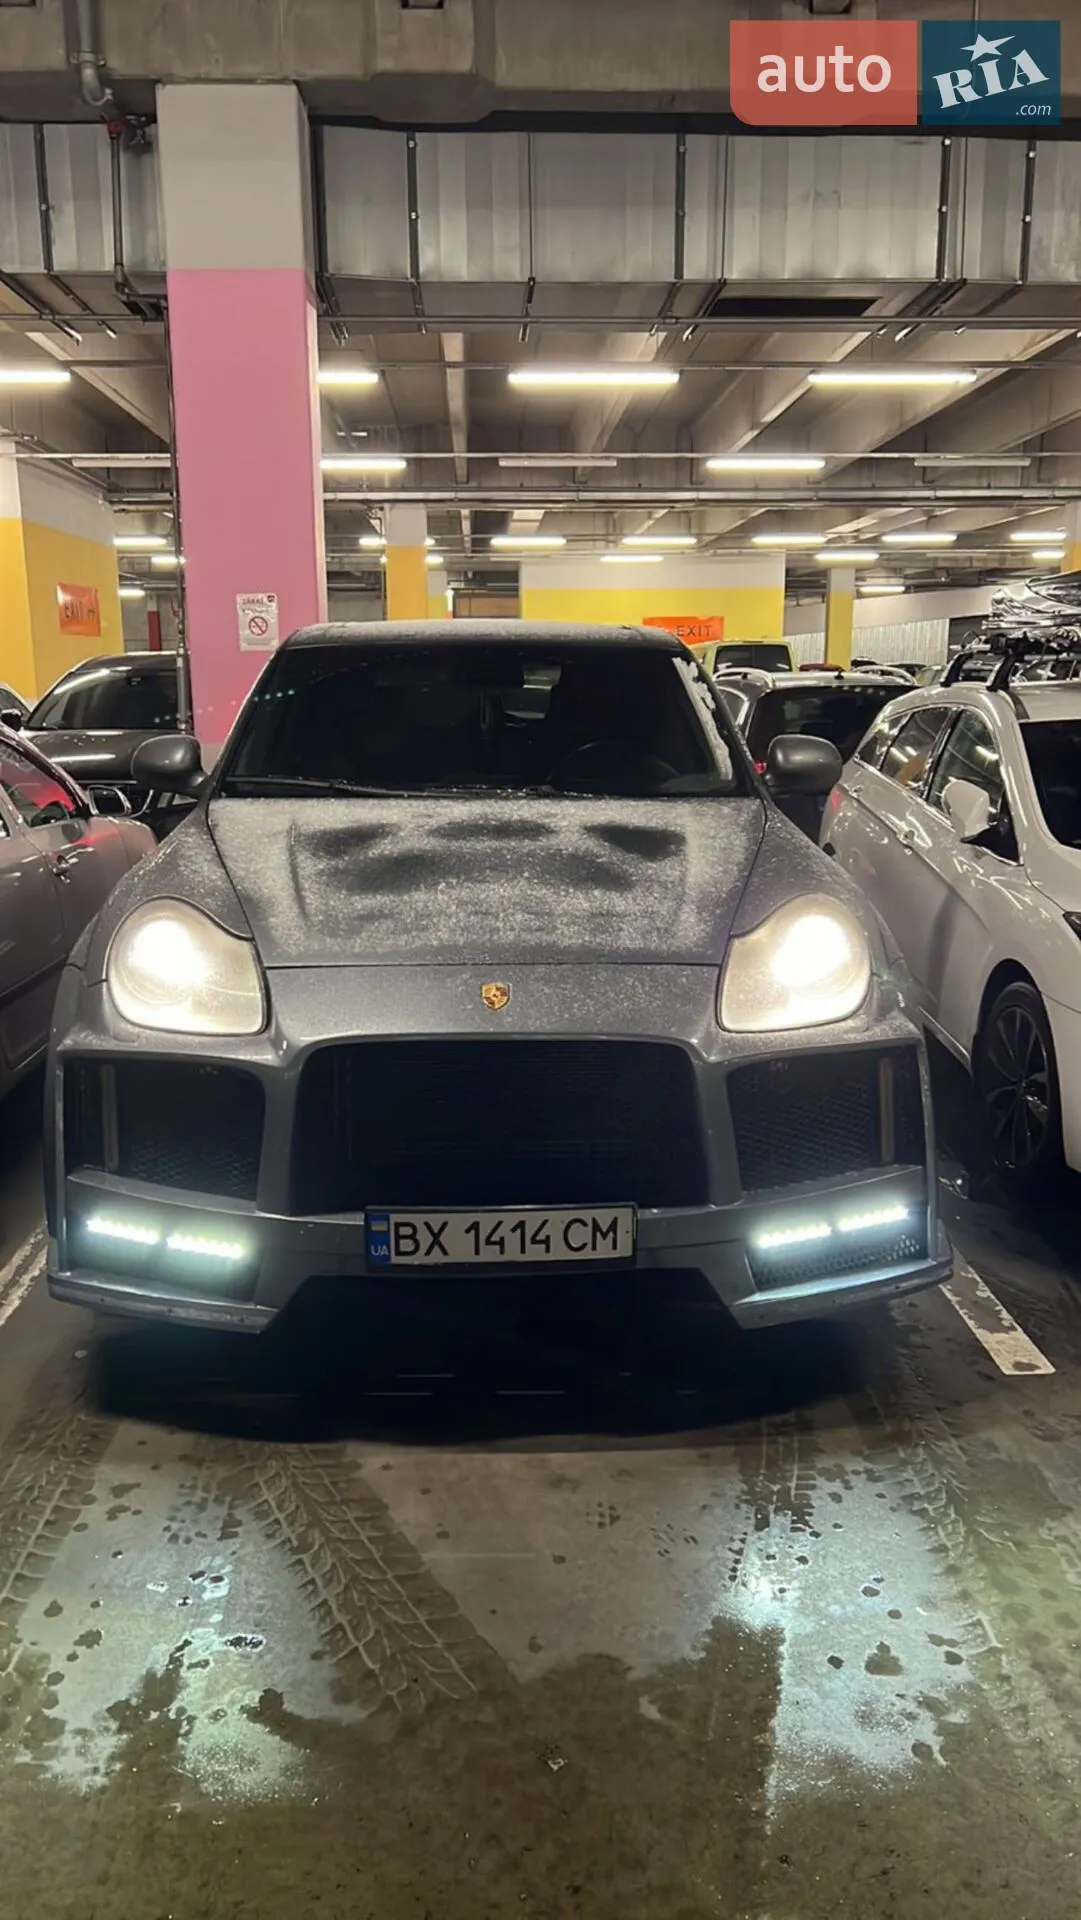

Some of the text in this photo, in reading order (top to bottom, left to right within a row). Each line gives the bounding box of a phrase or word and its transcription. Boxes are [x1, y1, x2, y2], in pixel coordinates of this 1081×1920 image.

[676, 625, 713, 637] EXIT
[394, 1216, 618, 1257] BX 1414 CM
[371, 1245, 389, 1257] UA
